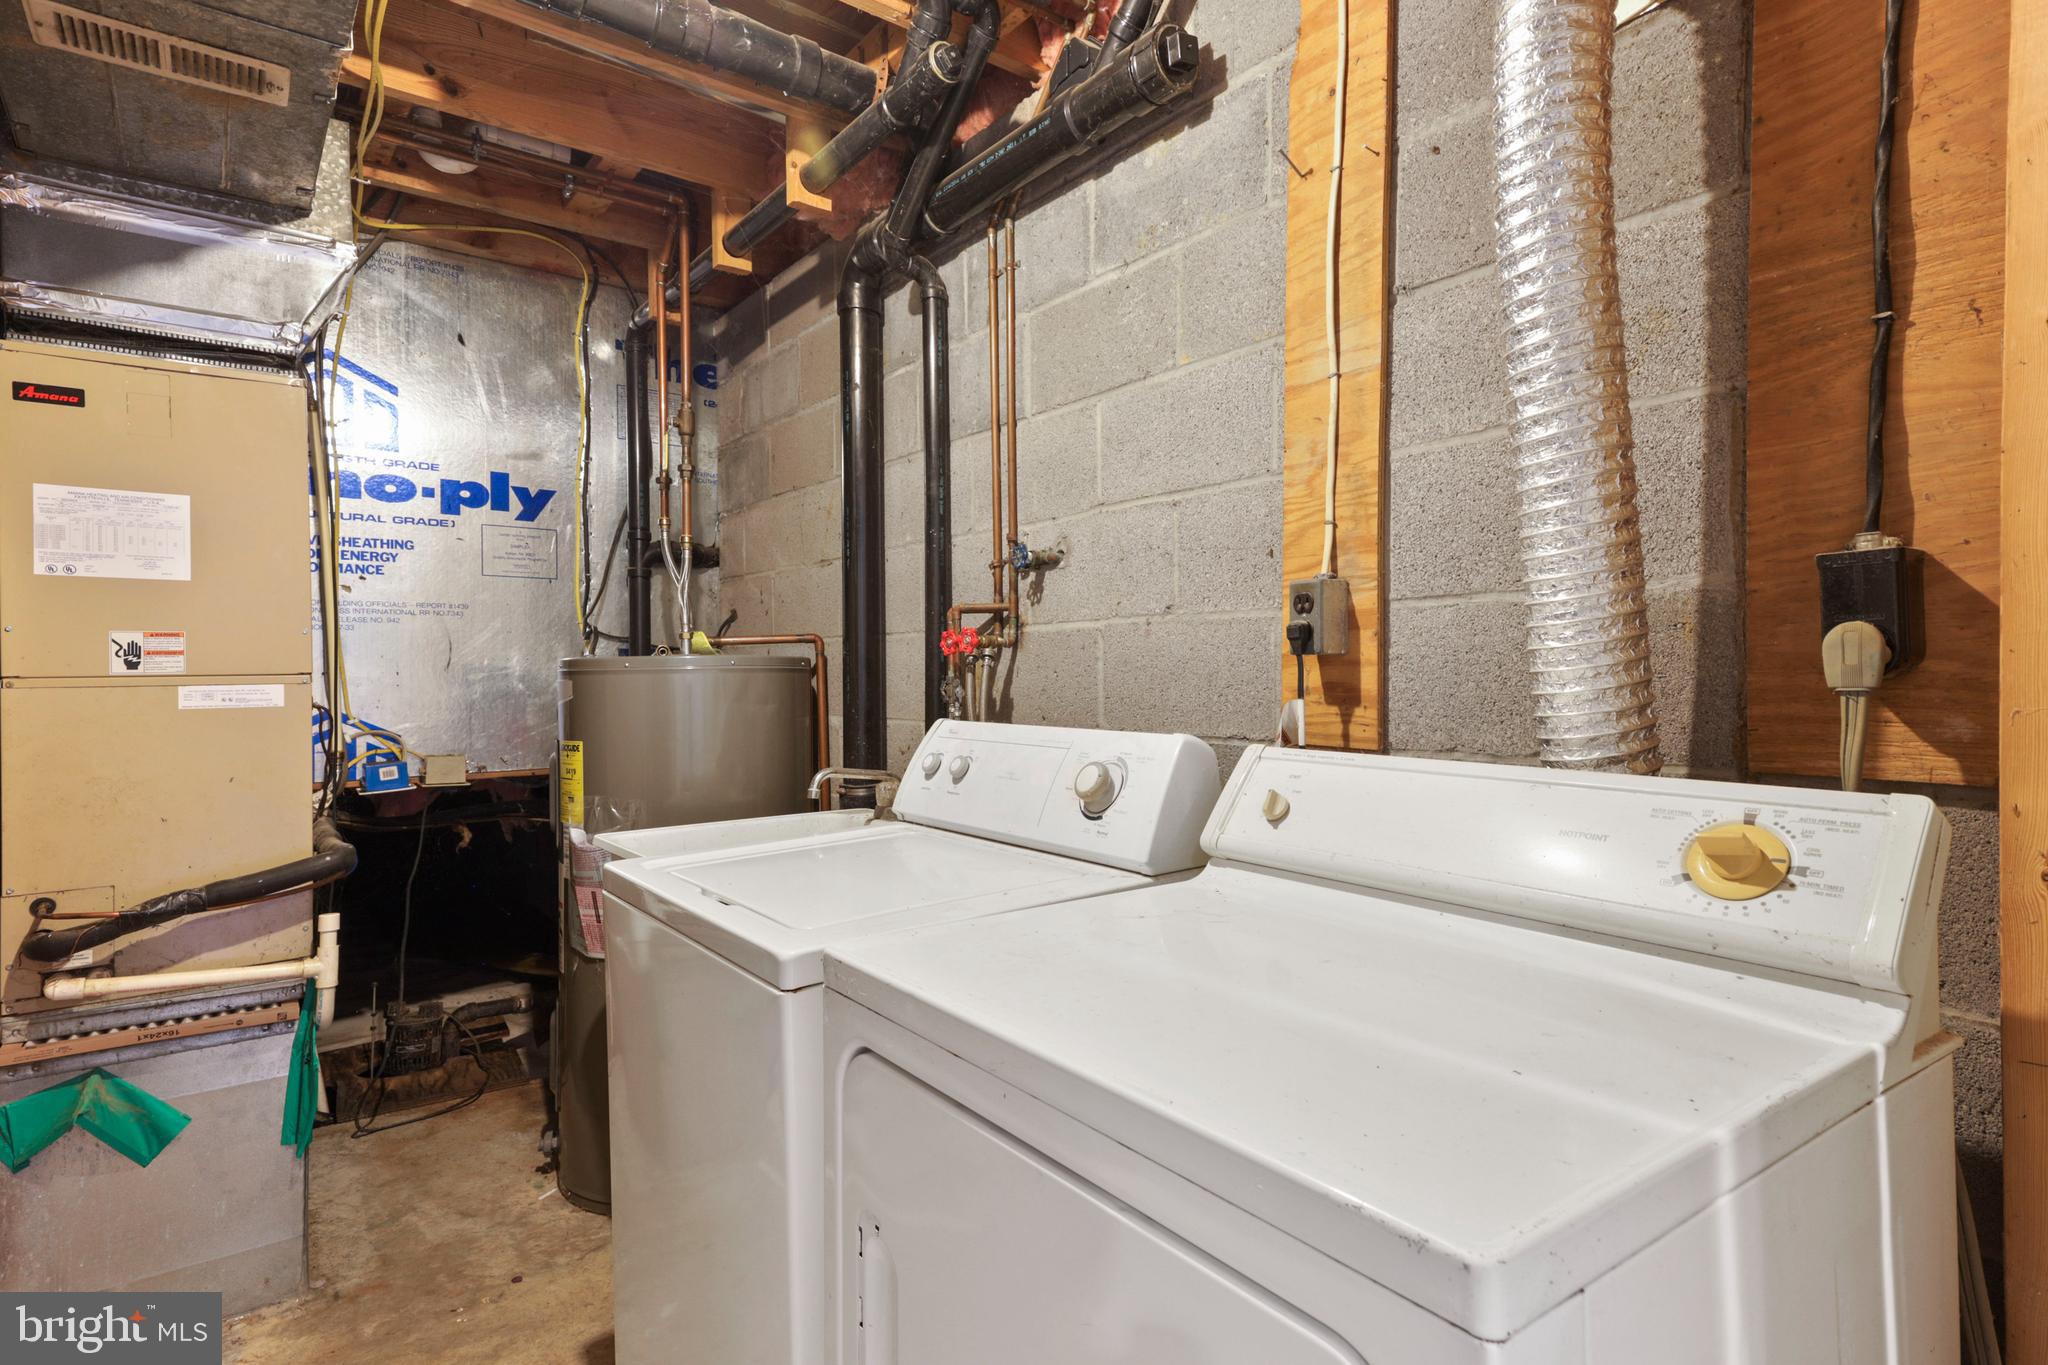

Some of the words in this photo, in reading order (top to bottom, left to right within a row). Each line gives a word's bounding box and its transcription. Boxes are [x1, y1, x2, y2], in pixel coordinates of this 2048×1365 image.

[19, 385, 80, 403] Amana
[383, 458, 440, 472] GRADE
[392, 515, 456, 528] GRADE)
[338, 536, 415, 551] HEATHING
[340, 550, 399, 563] ENERGY
[364, 600, 407, 609] OFFICIALS
[415, 602, 446, 610] REPORT
[351, 608, 417, 617] INTERNATIONAL
[137, 1030, 181, 1041] 16x24x1
